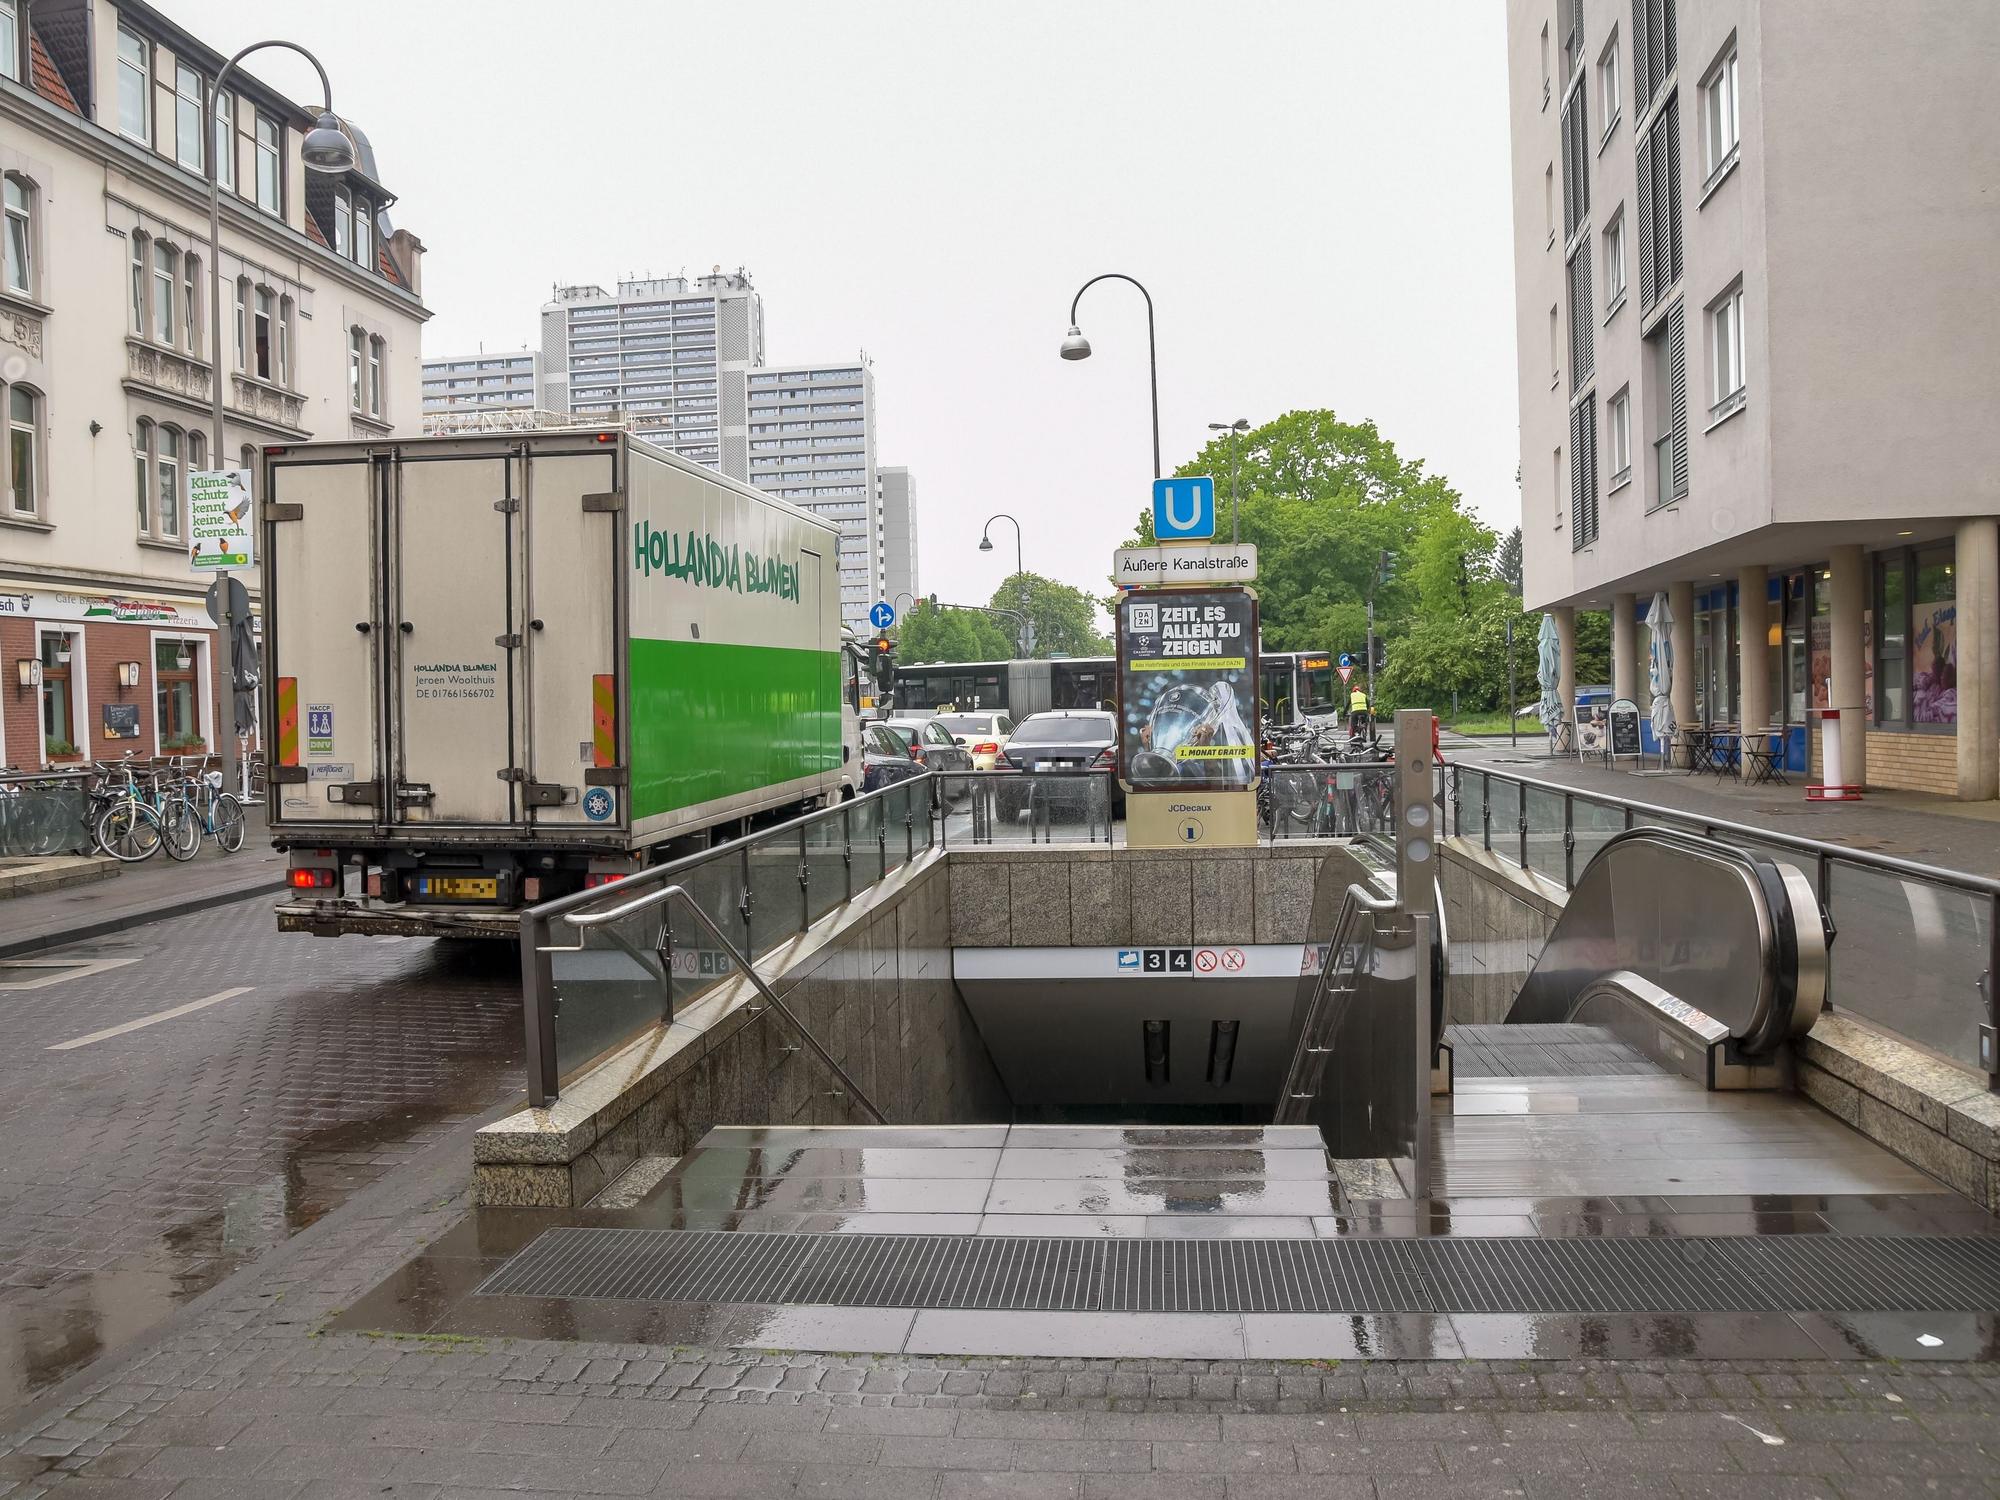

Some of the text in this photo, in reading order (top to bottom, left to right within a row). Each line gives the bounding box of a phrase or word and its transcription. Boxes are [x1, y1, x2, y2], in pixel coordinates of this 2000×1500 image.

[191, 477, 231, 489] Klima-
[192, 489, 229, 501] schutz
[192, 501, 226, 513] kennt
[1165, 486, 1201, 530] U
[193, 514, 224, 526] keine
[192, 527, 248, 538] Grenzen.
[634, 520, 799, 604] HOLLANDIA BLUMEN
[1122, 556, 1248, 572] Äußere Kanalstraße
[168, 615, 198, 626] Pizzeria
[1161, 606, 1226, 623] ZEIT, ES
[1162, 622, 1240, 639] ALLEN ZU
[1162, 640, 1222, 656] ZEIGEN
[414, 663, 496, 672] HOLLANDIA BLUMEN
[416, 675, 445, 686] Jeroen
[416, 689, 429, 698] DE
[1168, 804, 1212, 812] JCDecaux
[1149, 953, 1187, 968] 3 4
